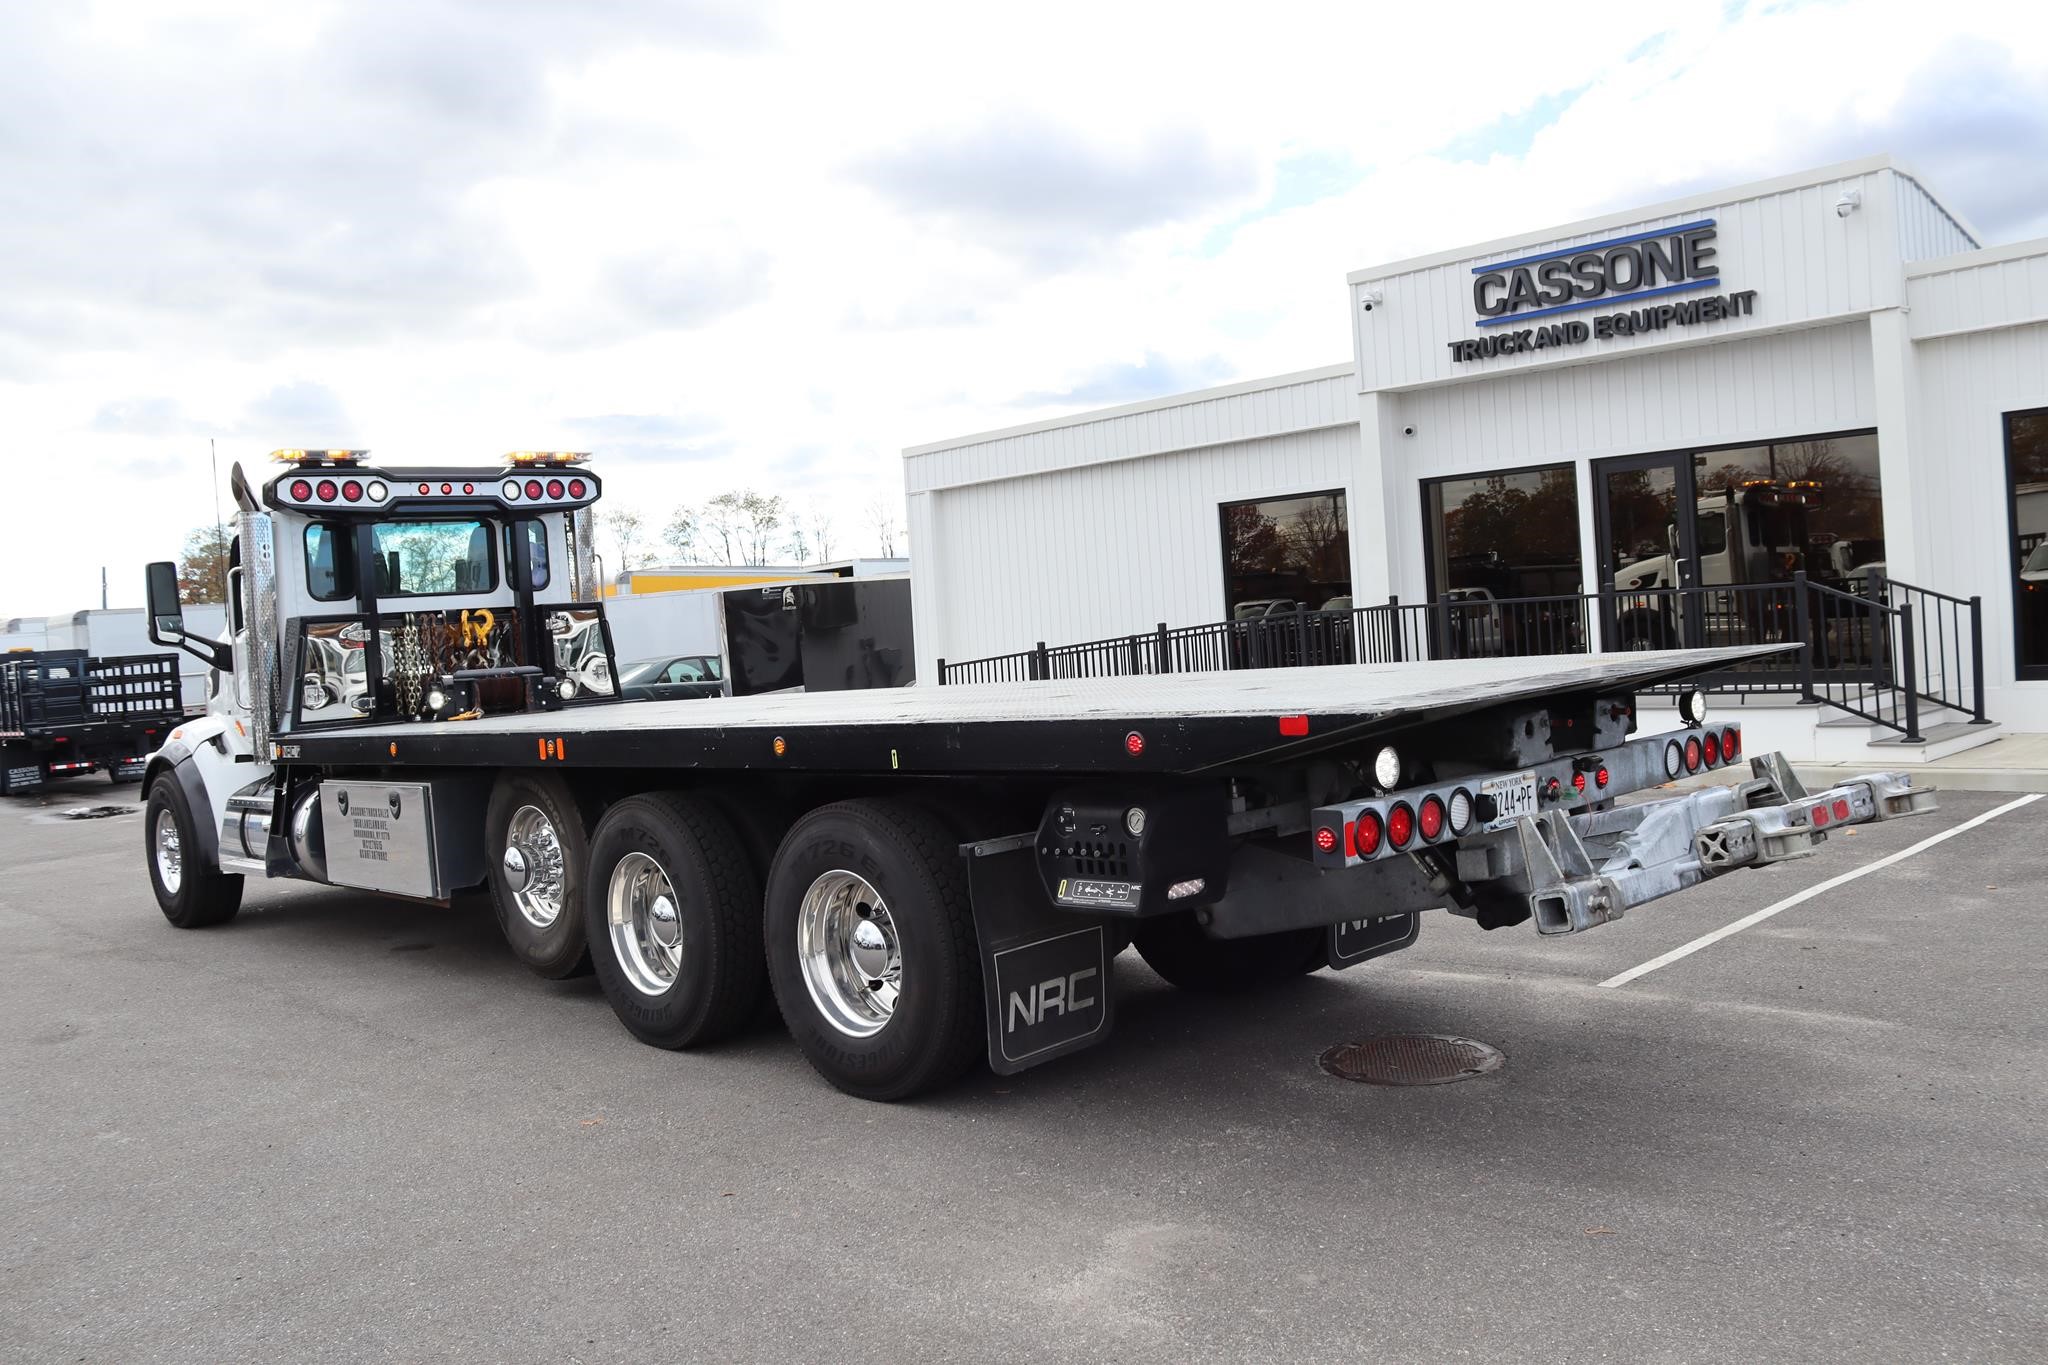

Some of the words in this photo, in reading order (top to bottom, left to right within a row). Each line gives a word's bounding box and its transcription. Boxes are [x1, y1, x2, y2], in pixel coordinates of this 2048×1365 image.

[1473, 228, 1720, 316] CASSONE
[1448, 328, 1535, 362] TRUCK
[1533, 320, 1589, 349] AND
[1594, 289, 1757, 339] EQUIPMENT
[1495, 780, 1508, 790] NEW
[1509, 776, 1523, 787] YORK
[1008, 967, 1097, 1033] NRC
